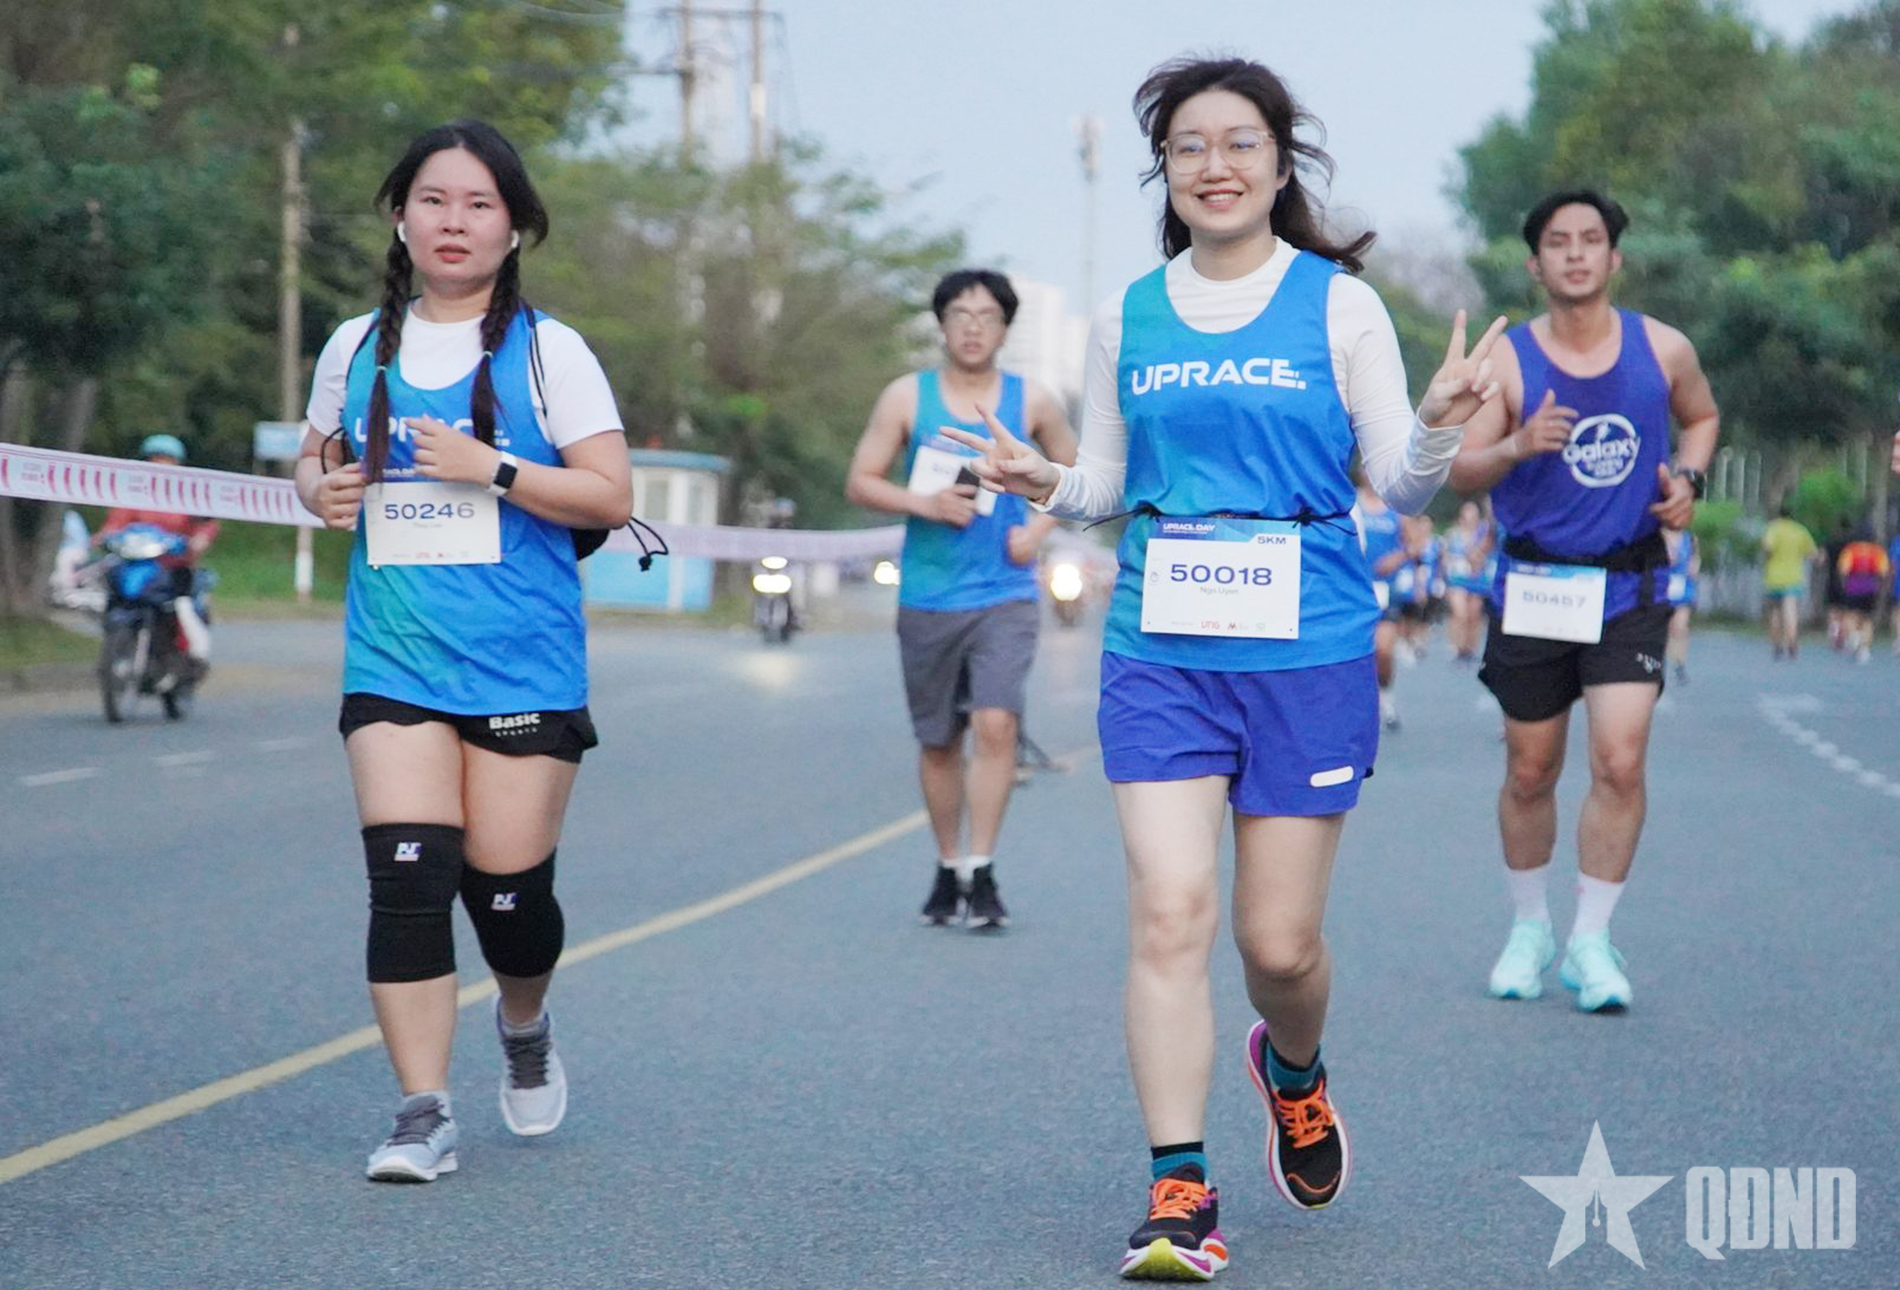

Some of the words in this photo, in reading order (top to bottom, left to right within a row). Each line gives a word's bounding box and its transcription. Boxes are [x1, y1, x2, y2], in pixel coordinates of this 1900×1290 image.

[1562, 436, 1641, 465] Galaxy
[384, 502, 475, 520] 50246
[1257, 536, 1287, 545] 5KM
[1170, 564, 1272, 586] 50018
[489, 712, 540, 730] Basic
